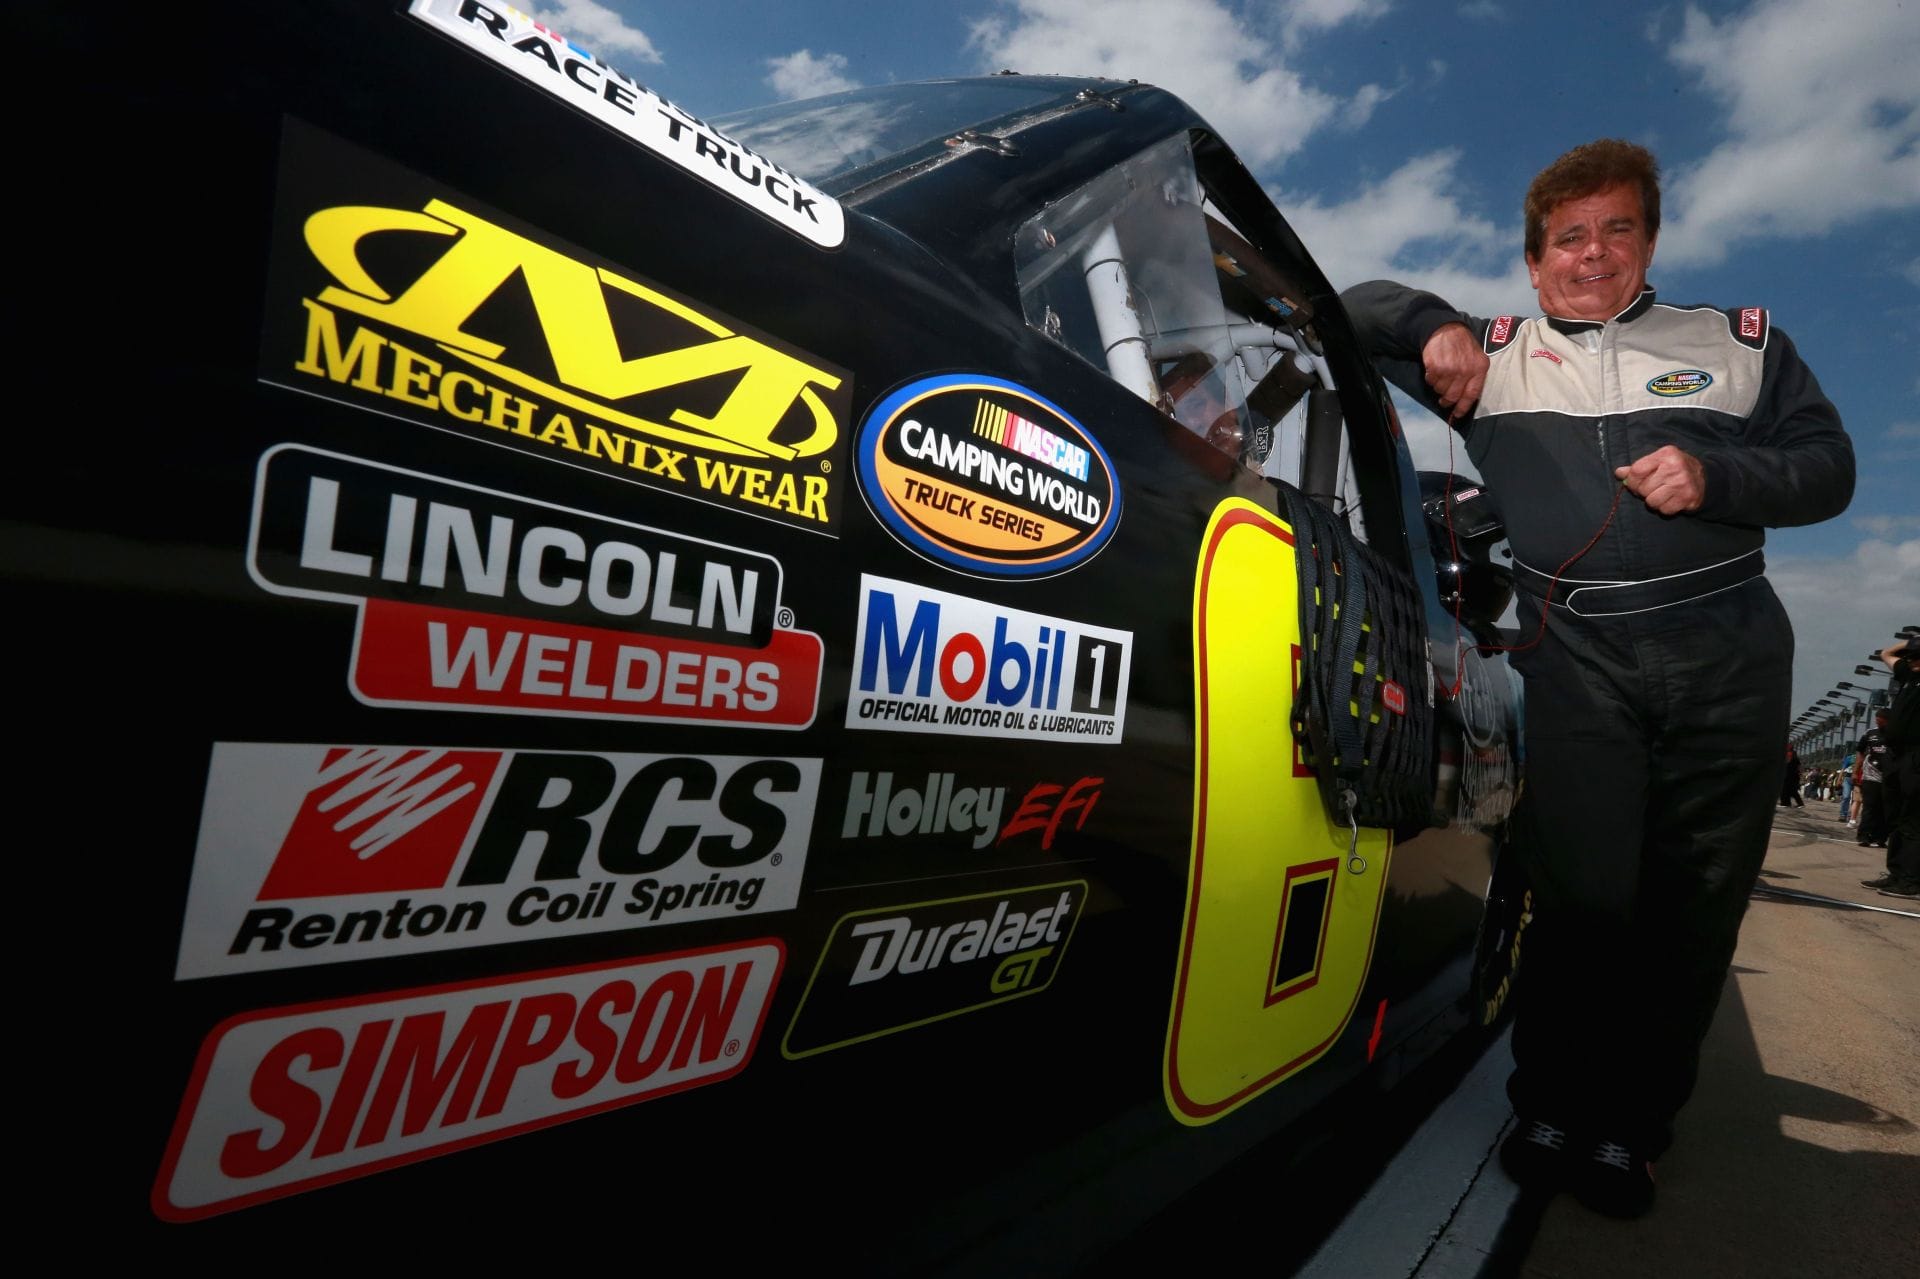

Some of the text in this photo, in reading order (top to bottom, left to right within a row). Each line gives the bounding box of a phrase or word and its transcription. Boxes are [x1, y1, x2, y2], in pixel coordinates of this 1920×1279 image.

[459, 0, 638, 116] RACE
[658, 108, 820, 224] TRUCK
[295, 297, 829, 523] MECHANIX WEAR
[1013, 416, 1087, 482] NASCAR
[900, 419, 1101, 526] CAMPING WORLD
[904, 477, 1045, 542] TRUCK SERIES
[300, 475, 760, 635] LINCOLN
[427, 620, 780, 712] WELDERS
[859, 588, 1107, 711] Mobil 1
[858, 698, 1115, 736] OFFICIAL MOTOR OIL & LUBRICANTS
[457, 752, 801, 887] RCS
[841, 771, 1006, 850] Holley
[227, 872, 765, 956] Renton Coil Spring
[848, 891, 1072, 987] Duralast
[990, 946, 1055, 994] GT
[220, 960, 755, 1180] SIMPSON
